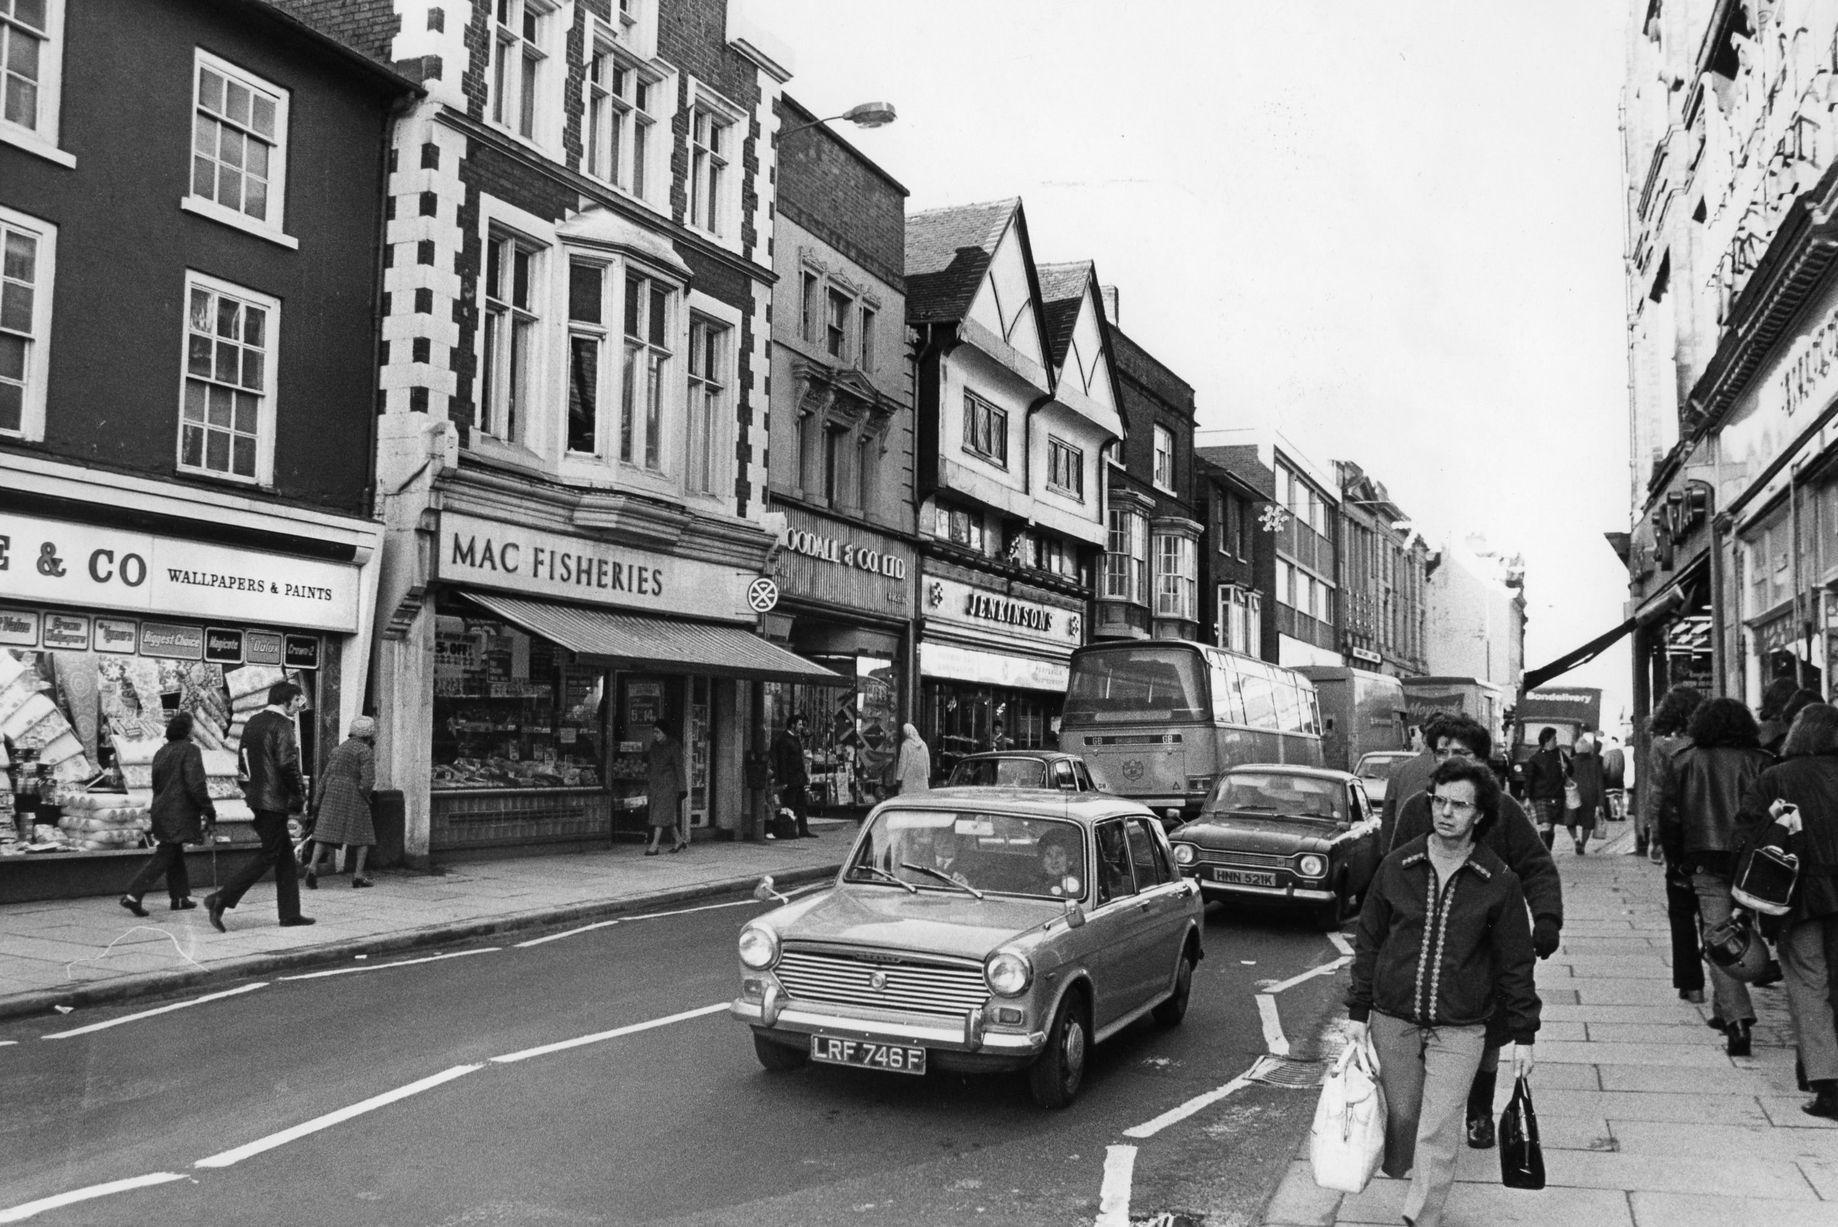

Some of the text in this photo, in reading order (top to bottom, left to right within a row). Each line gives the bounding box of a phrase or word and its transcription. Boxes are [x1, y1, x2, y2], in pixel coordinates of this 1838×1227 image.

[786, 527, 840, 563] OODALL
[844, 543, 853, 567] &
[37, 541, 67, 577] &
[88, 549, 147, 587] CO
[451, 532, 663, 596] MAC FISHERIES
[167, 568, 332, 601] WALLPAPERS & PAINTS
[968, 594, 1053, 631] JENKINSONS
[143, 631, 200, 649] Biggest Choice
[253, 639, 280, 654] Dulux
[1216, 869, 1272, 886] HNN 521K
[814, 1037, 922, 1069] LRF 746F
